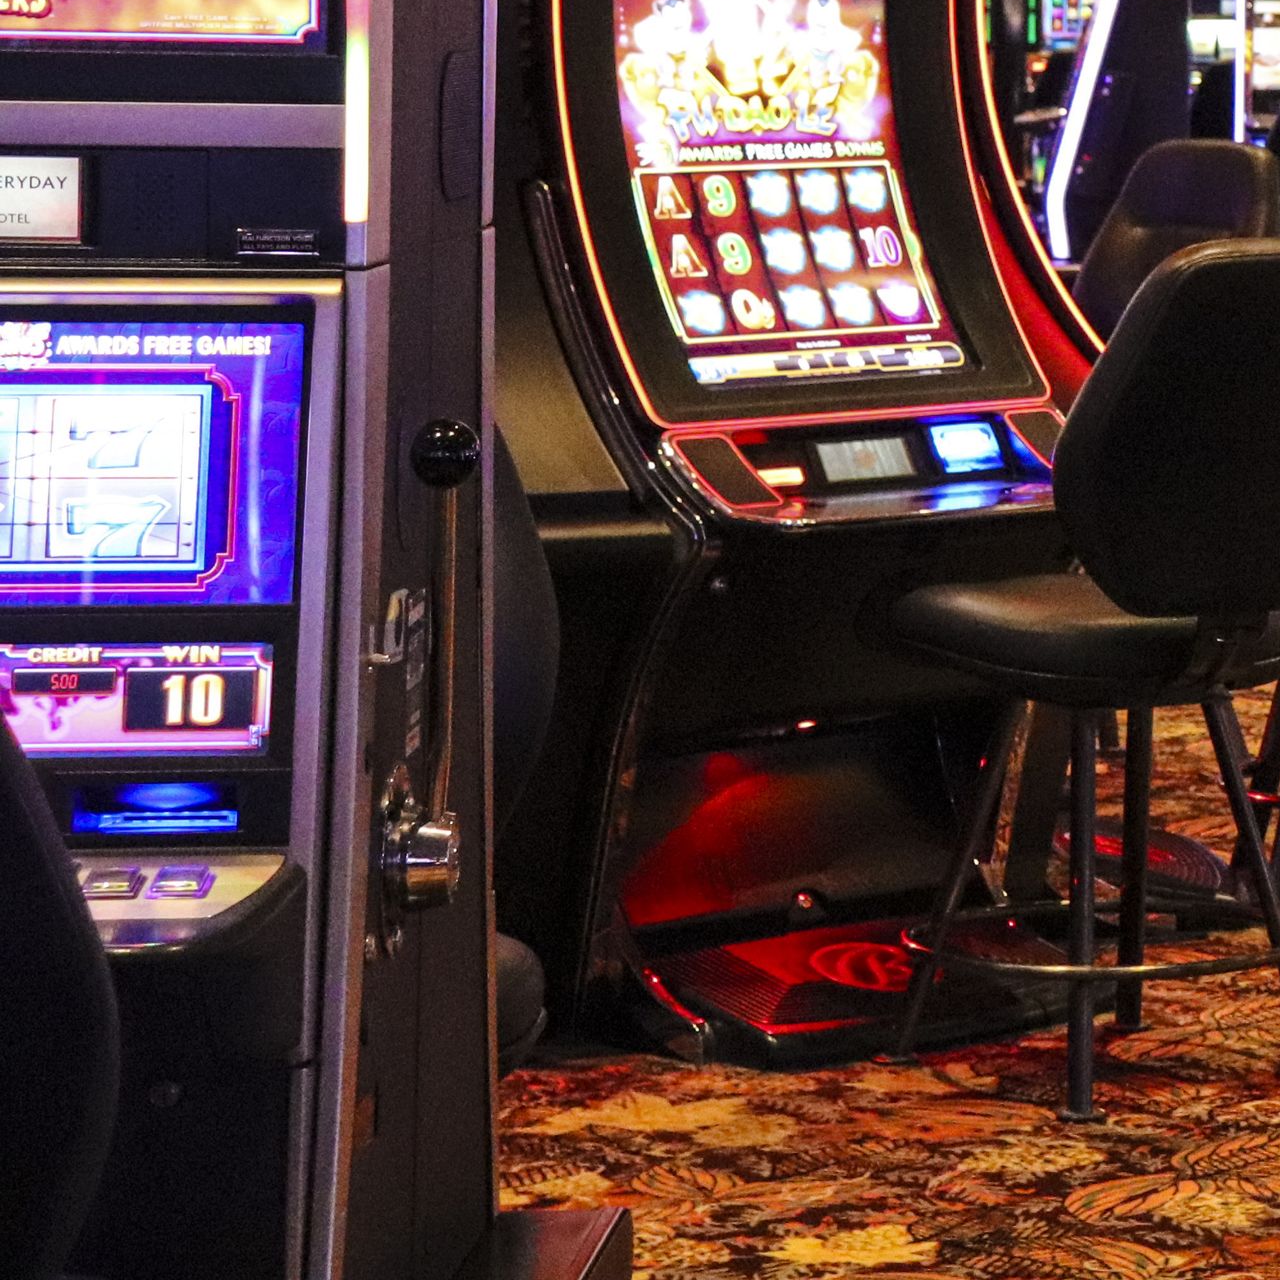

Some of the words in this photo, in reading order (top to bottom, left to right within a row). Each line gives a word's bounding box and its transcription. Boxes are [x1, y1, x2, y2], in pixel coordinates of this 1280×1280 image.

[679, 145, 742, 162] AWARDS
[745, 143, 784, 160] FREE
[784, 143, 833, 160] GAMES
[834, 141, 884, 157] BONUS
[703, 175, 736, 218] 9
[717, 233, 752, 275] 9
[859, 226, 902, 267] 10
[56, 335, 140, 356] AWARDS
[143, 335, 193, 356] FREE
[196, 335, 272, 356] GAMES!
[27, 647, 102, 664] CREDIT
[162, 646, 221, 664] WIN
[162, 673, 225, 726] 10
